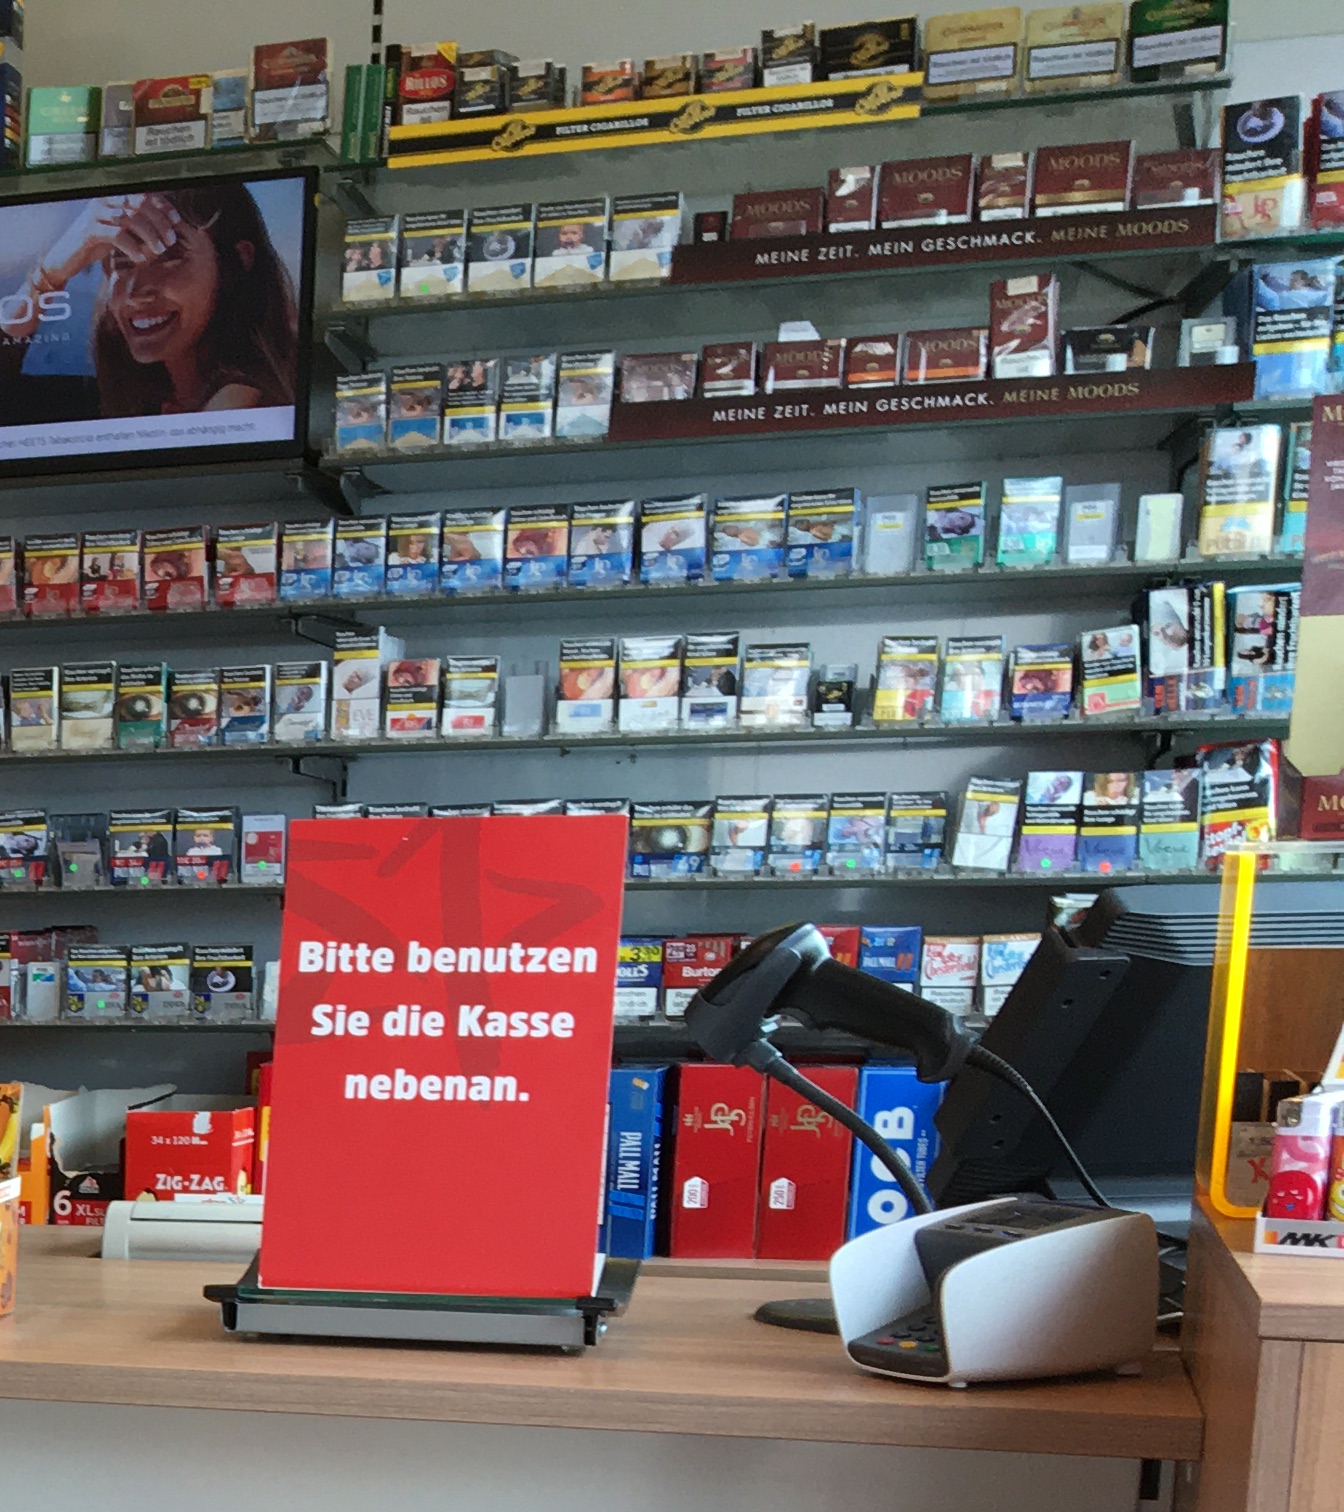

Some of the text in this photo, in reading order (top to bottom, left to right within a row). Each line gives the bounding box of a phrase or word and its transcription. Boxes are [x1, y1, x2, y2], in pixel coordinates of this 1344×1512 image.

[755, 218, 1190, 265] MEINE ZEIT. MEIN GESCHMACK. MEINE MOODS
[712, 381, 1141, 423] MEINE ZEIT. MEIN GESCHMACK. MEINE MOODS
[297, 940, 598, 974] Bitte benutzen
[310, 1003, 576, 1038] Sie die Kasse
[344, 1068, 530, 1102] nebenan.
[155, 1173, 226, 1192] ZIG-ZAG
[53, 1189, 73, 1217] 6
